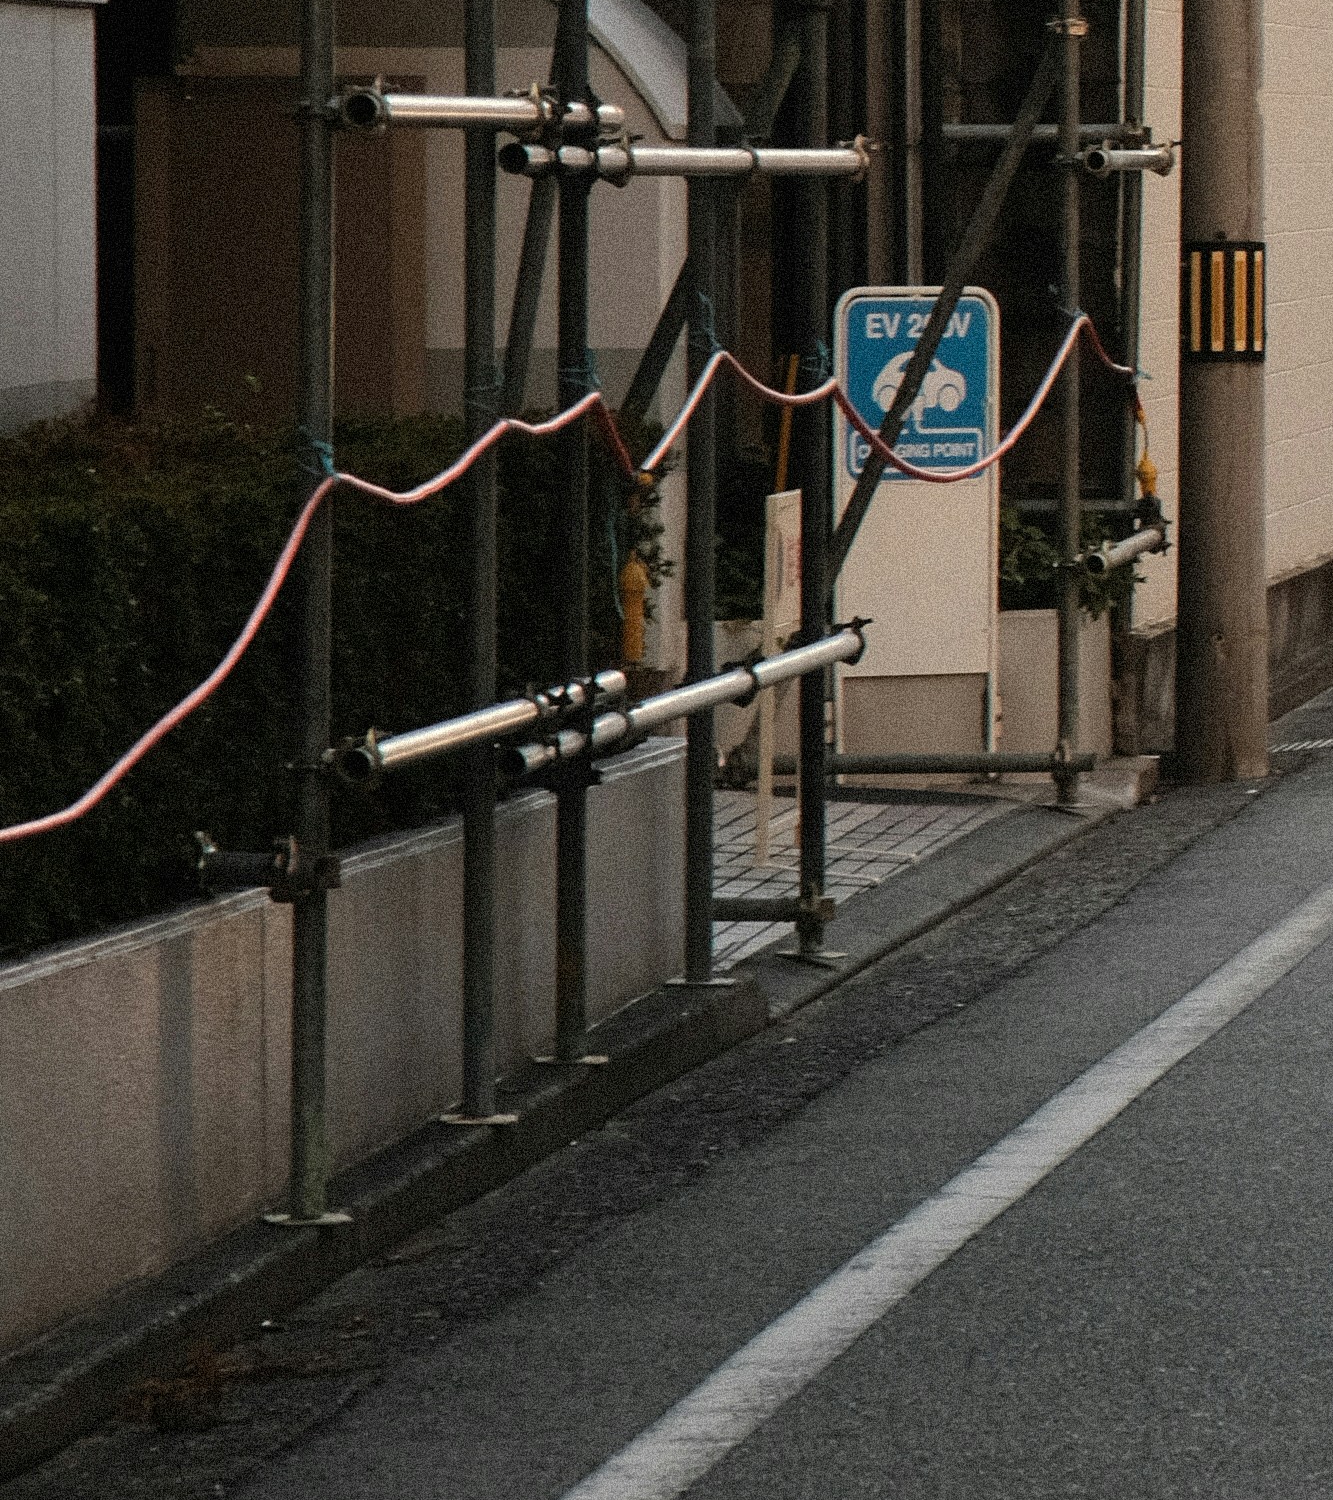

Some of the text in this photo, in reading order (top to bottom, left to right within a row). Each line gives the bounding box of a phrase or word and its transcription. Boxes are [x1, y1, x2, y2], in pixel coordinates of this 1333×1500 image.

[865, 311, 972, 339] EV 2V
[857, 443, 977, 460] CGING POINT
